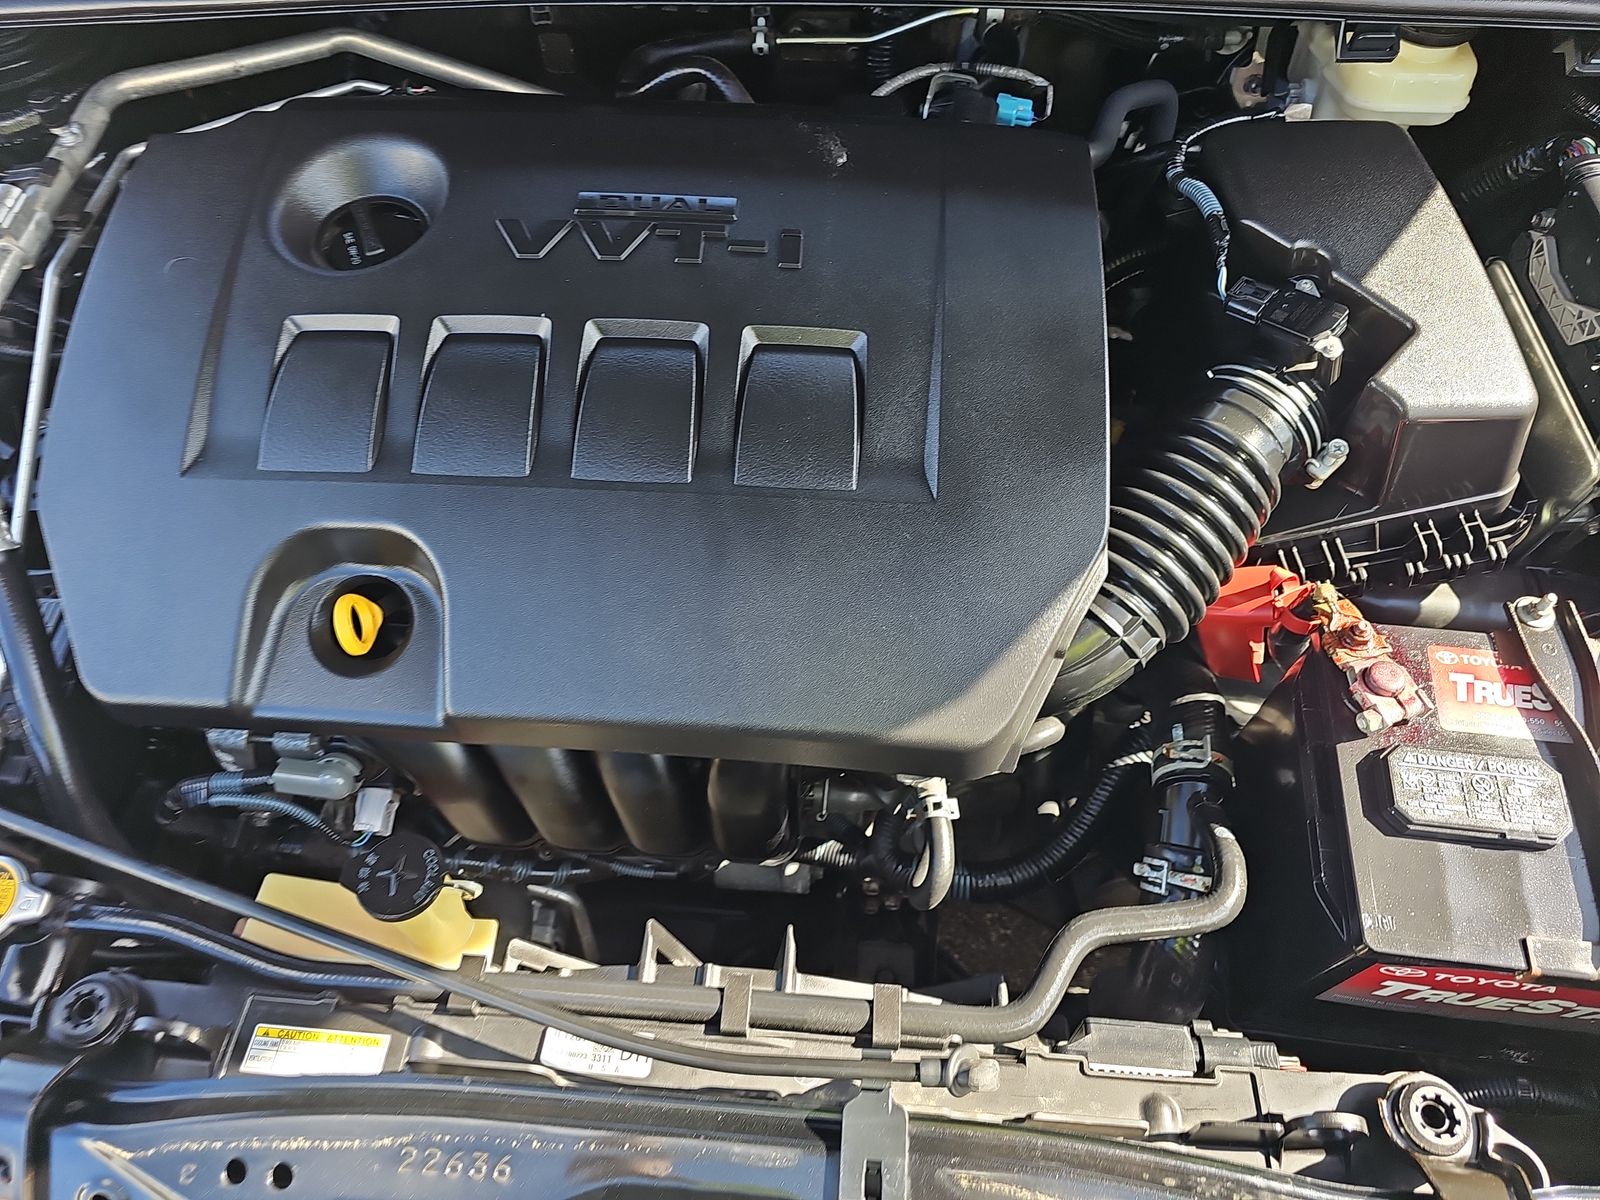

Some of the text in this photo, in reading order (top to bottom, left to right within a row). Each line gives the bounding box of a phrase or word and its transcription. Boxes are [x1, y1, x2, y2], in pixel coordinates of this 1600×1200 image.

[598, 194, 725, 213] DUAL
[1417, 754, 1474, 771] DANGER
[1488, 762, 1540, 777] POISON
[1435, 972, 1557, 994] TOYOTA
[277, 1029, 381, 1047] CAUTION ATTENTION
[397, 1146, 513, 1184] 22636
